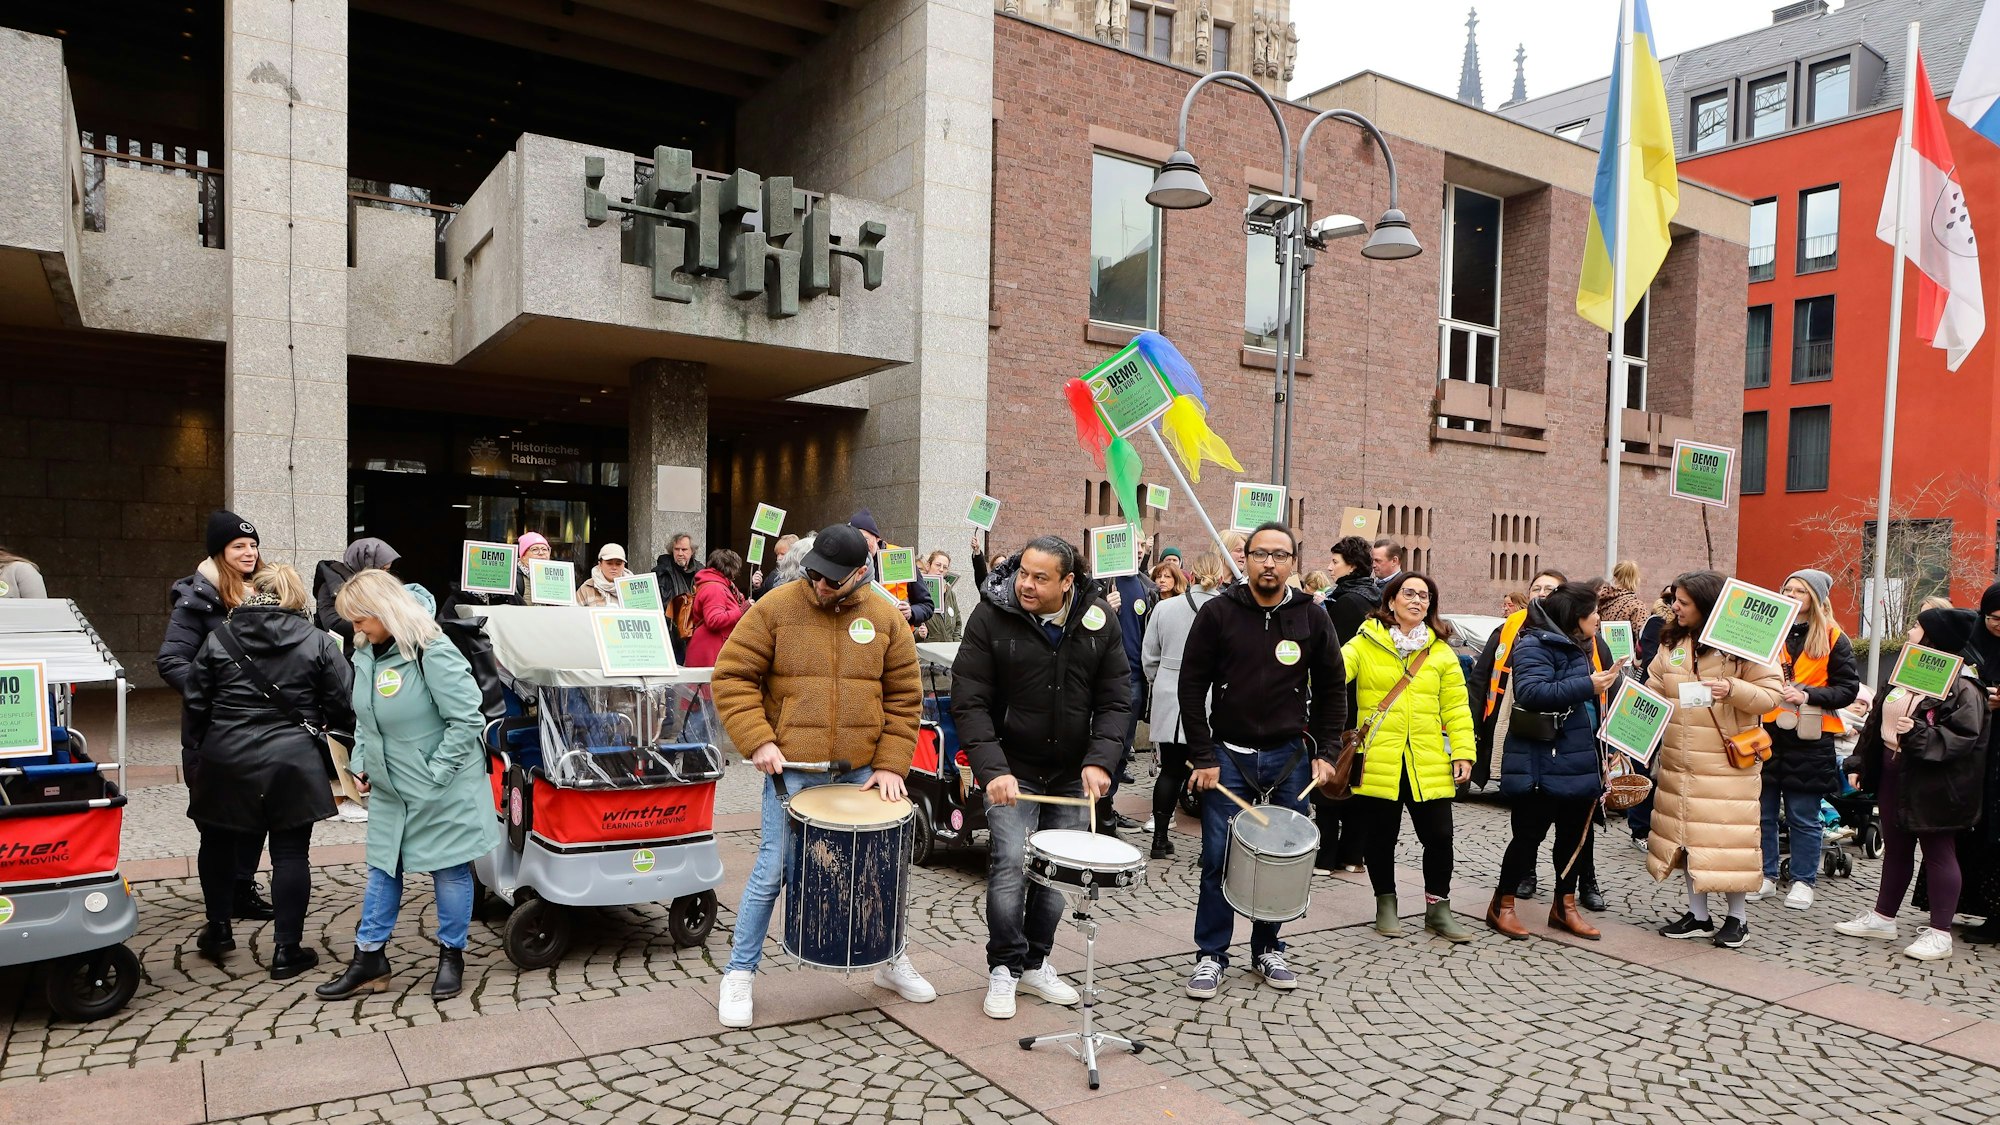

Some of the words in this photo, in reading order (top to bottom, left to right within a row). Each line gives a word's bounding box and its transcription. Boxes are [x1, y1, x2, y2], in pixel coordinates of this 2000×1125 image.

[1106, 360, 1138, 389] DEMO
[1113, 385, 1124, 396] U3
[1122, 377, 1136, 390] VOR
[1134, 372, 1143, 382] 12
[511, 441, 580, 456] Historisches
[511, 453, 557, 466] Rathaus
[1692, 452, 1719, 467] DEMO
[1691, 463, 1699, 471] U3
[1699, 465, 1710, 473] VOR
[1710, 467, 1718, 475] 12
[1250, 491, 1273, 503] DEMO
[980, 500, 993, 510] DEMO
[1106, 532, 1127, 544] DEMO
[481, 550, 505, 562] DEMO
[890, 553, 907, 561] DEMO
[544, 566, 564, 577] DEMO
[629, 580, 649, 591] DEMO
[1743, 596, 1779, 618] DEMO
[1739, 608, 1750, 618] U3
[1750, 612, 1765, 623] VOR
[1764, 617, 1774, 626] 12
[617, 619, 651, 632] DEMO
[1611, 628, 1625, 638] DEMO
[620, 631, 630, 640] U3
[631, 632, 644, 640] VOR
[645, 632, 653, 640] 12
[1919, 653, 1947, 668] DEMO
[0, 676, 20, 694] MO
[9, 694, 20, 705] 12
[1634, 695, 1659, 718] DEMO
[1630, 707, 1638, 716] U3
[1637, 711, 1648, 722] VOR
[1647, 716, 1654, 726] 12
[602, 804, 688, 822] winther
[601, 820, 643, 830] LEARNING
[644, 819, 654, 827] BY
[655, 815, 686, 826] MOVING
[0, 839, 69, 859] ther
[0, 860, 14, 868] BY
[19, 853, 70, 866] MOVING
